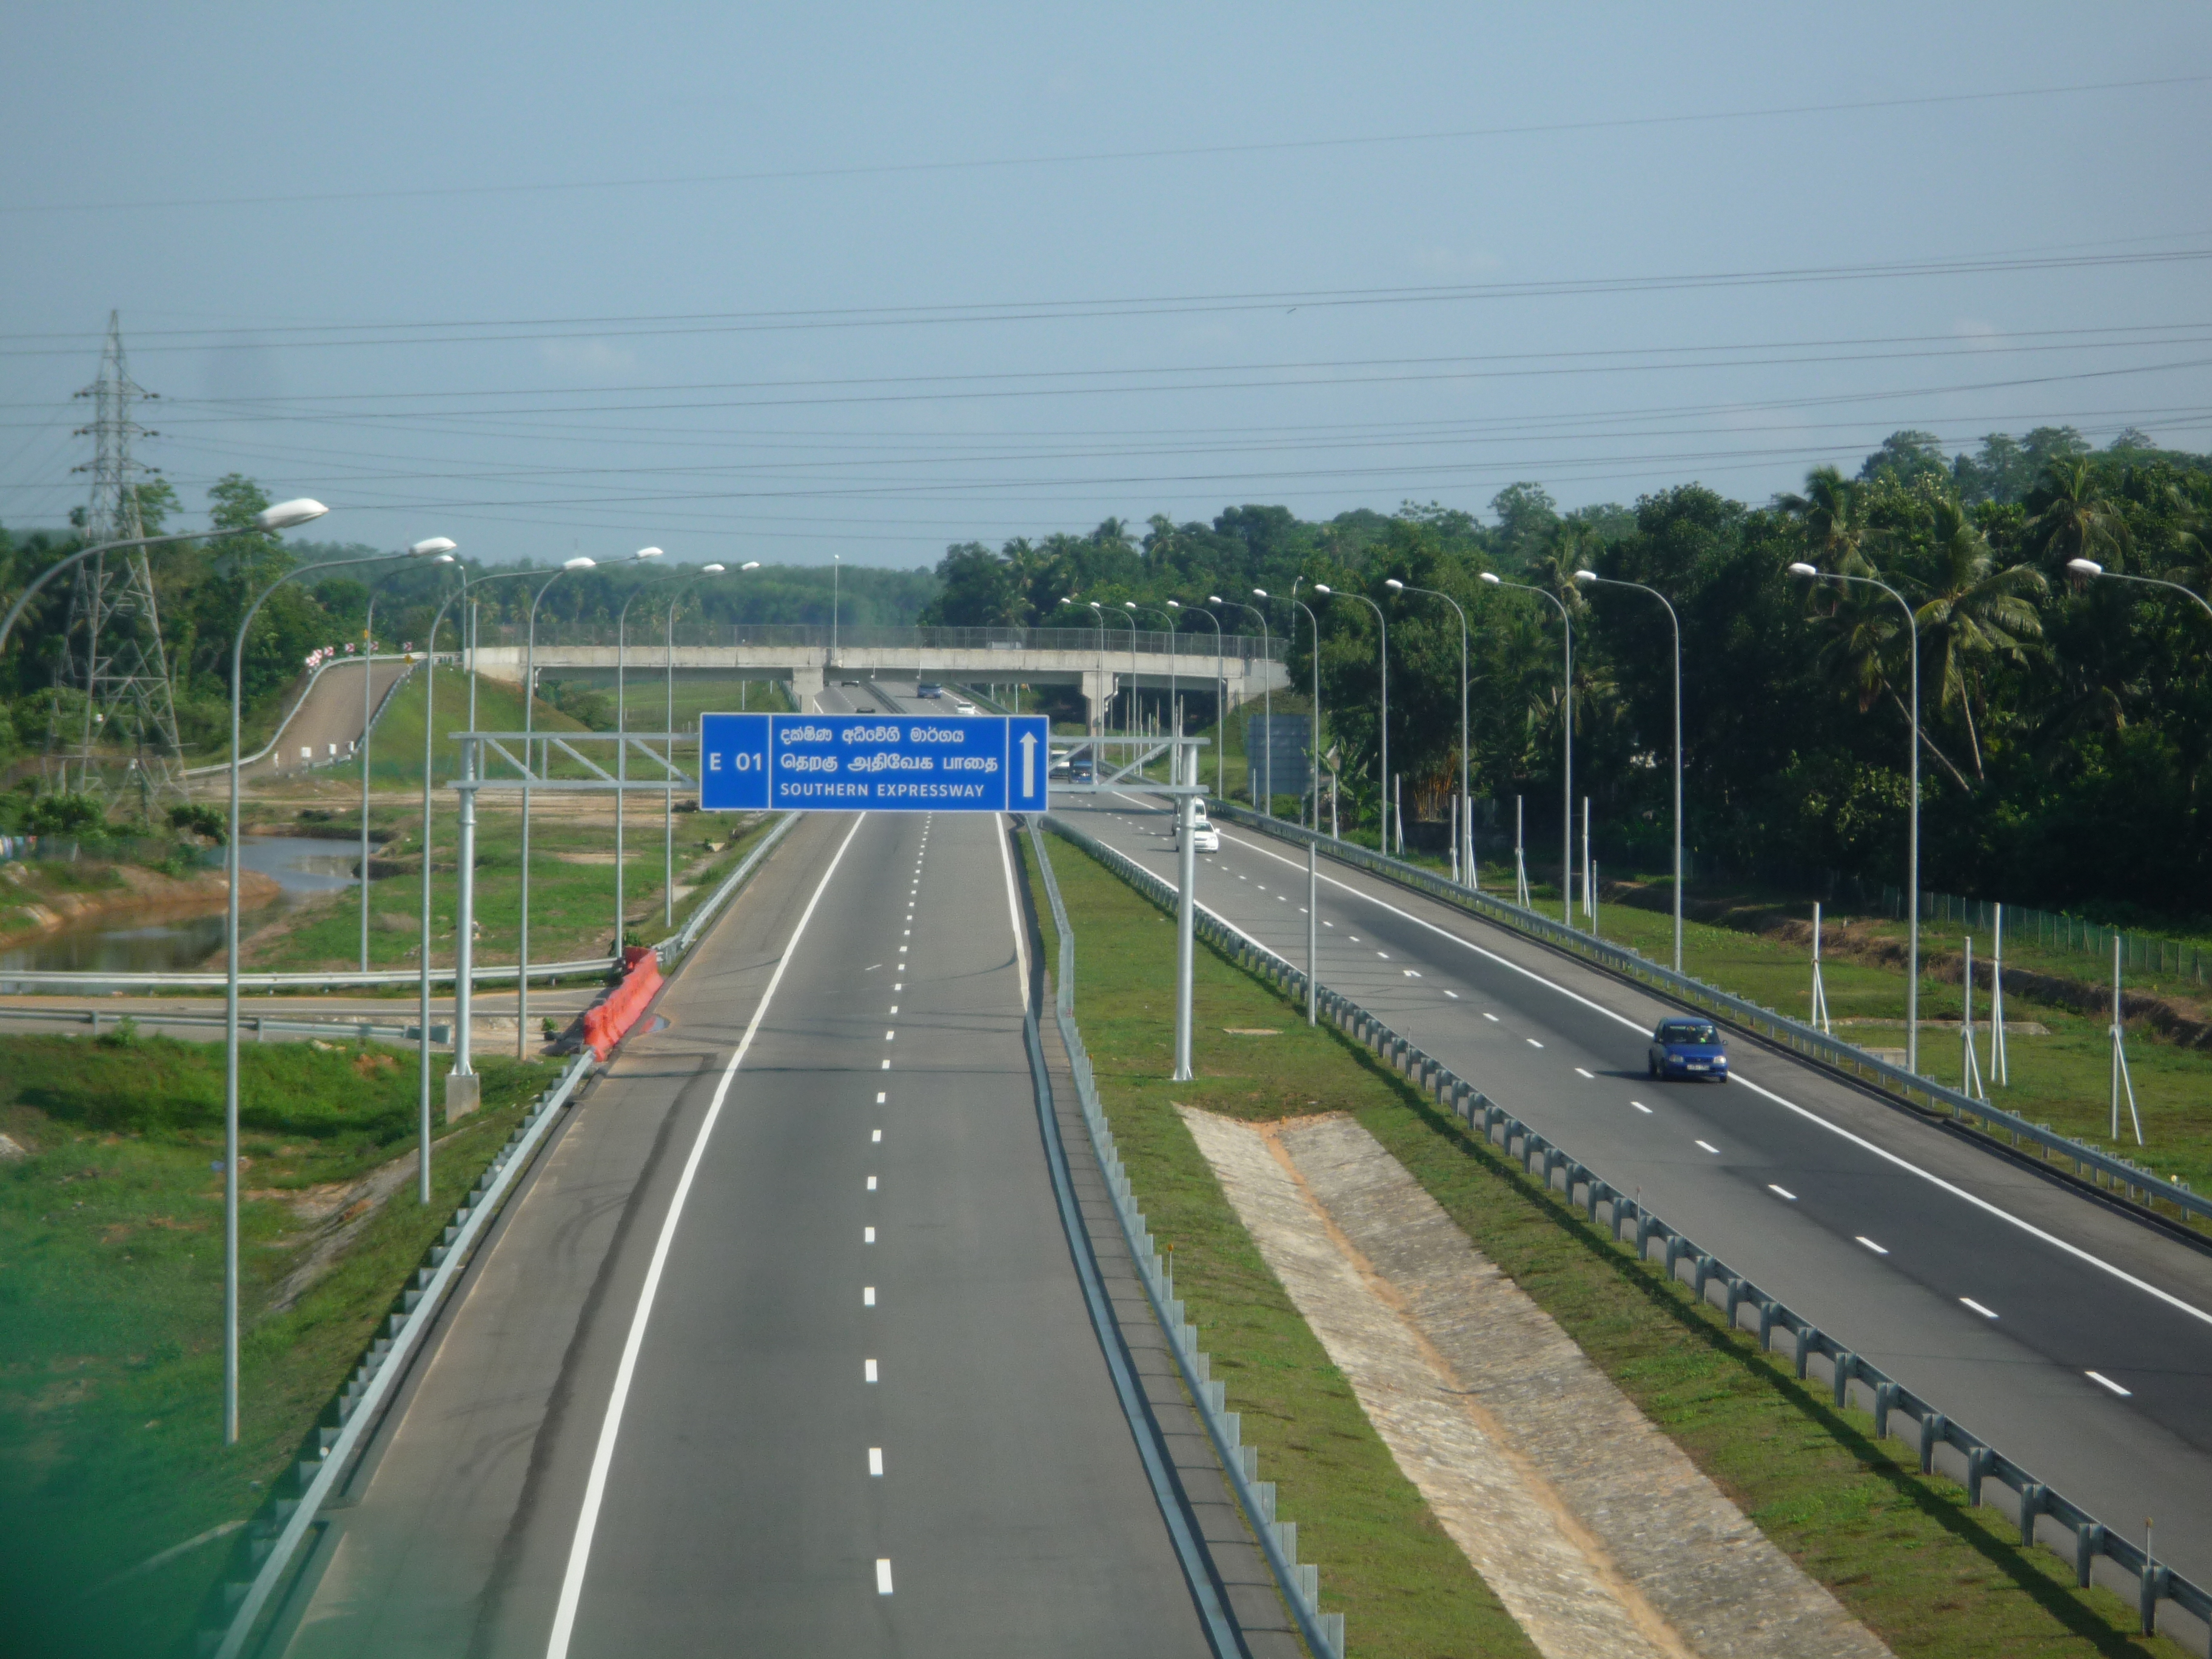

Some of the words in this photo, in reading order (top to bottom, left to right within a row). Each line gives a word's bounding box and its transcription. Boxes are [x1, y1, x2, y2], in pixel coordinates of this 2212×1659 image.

[910, 726, 965, 743] මාර්ගය
[710, 752, 722, 771] E
[736, 752, 761, 771] 01
[847, 753, 934, 773] அதிவேக
[943, 757, 998, 773] பாதை
[781, 783, 868, 796] SOUTHERN
[877, 783, 984, 797] EXPRESSWAY
